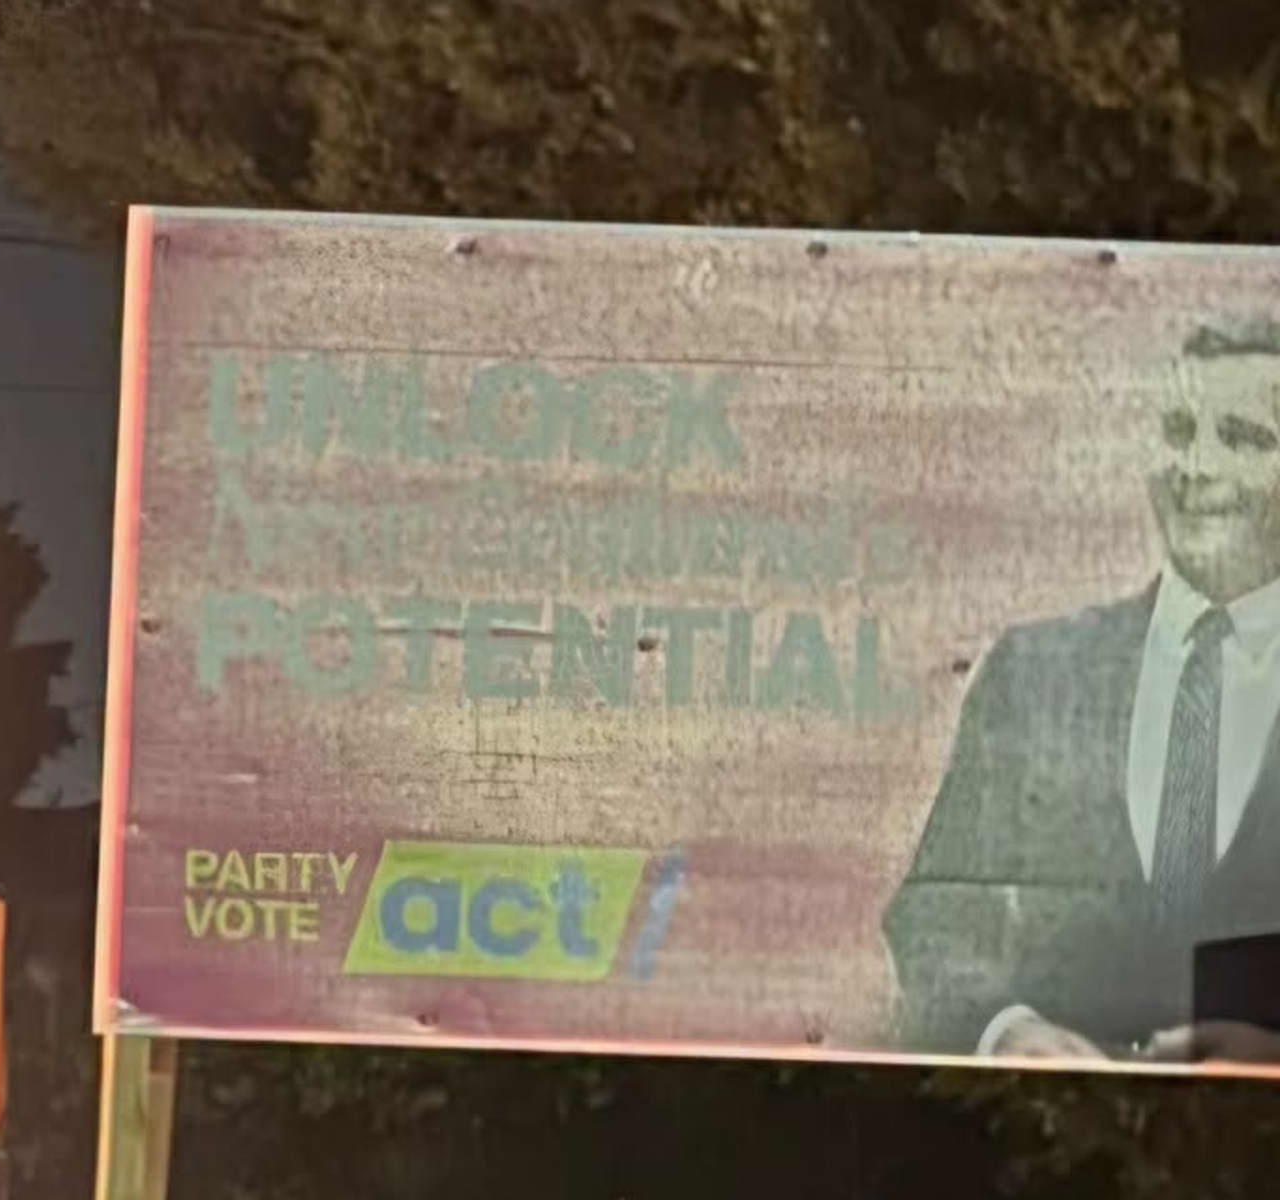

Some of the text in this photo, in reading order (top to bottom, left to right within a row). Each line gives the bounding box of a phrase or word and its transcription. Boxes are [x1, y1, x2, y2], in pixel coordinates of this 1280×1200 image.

[206, 350, 744, 471] UNLOCK
[196, 589, 921, 717] POTENTIAL
[184, 897, 320, 941] VOTE
[185, 849, 358, 895] PARTY
[379, 856, 600, 957] act
